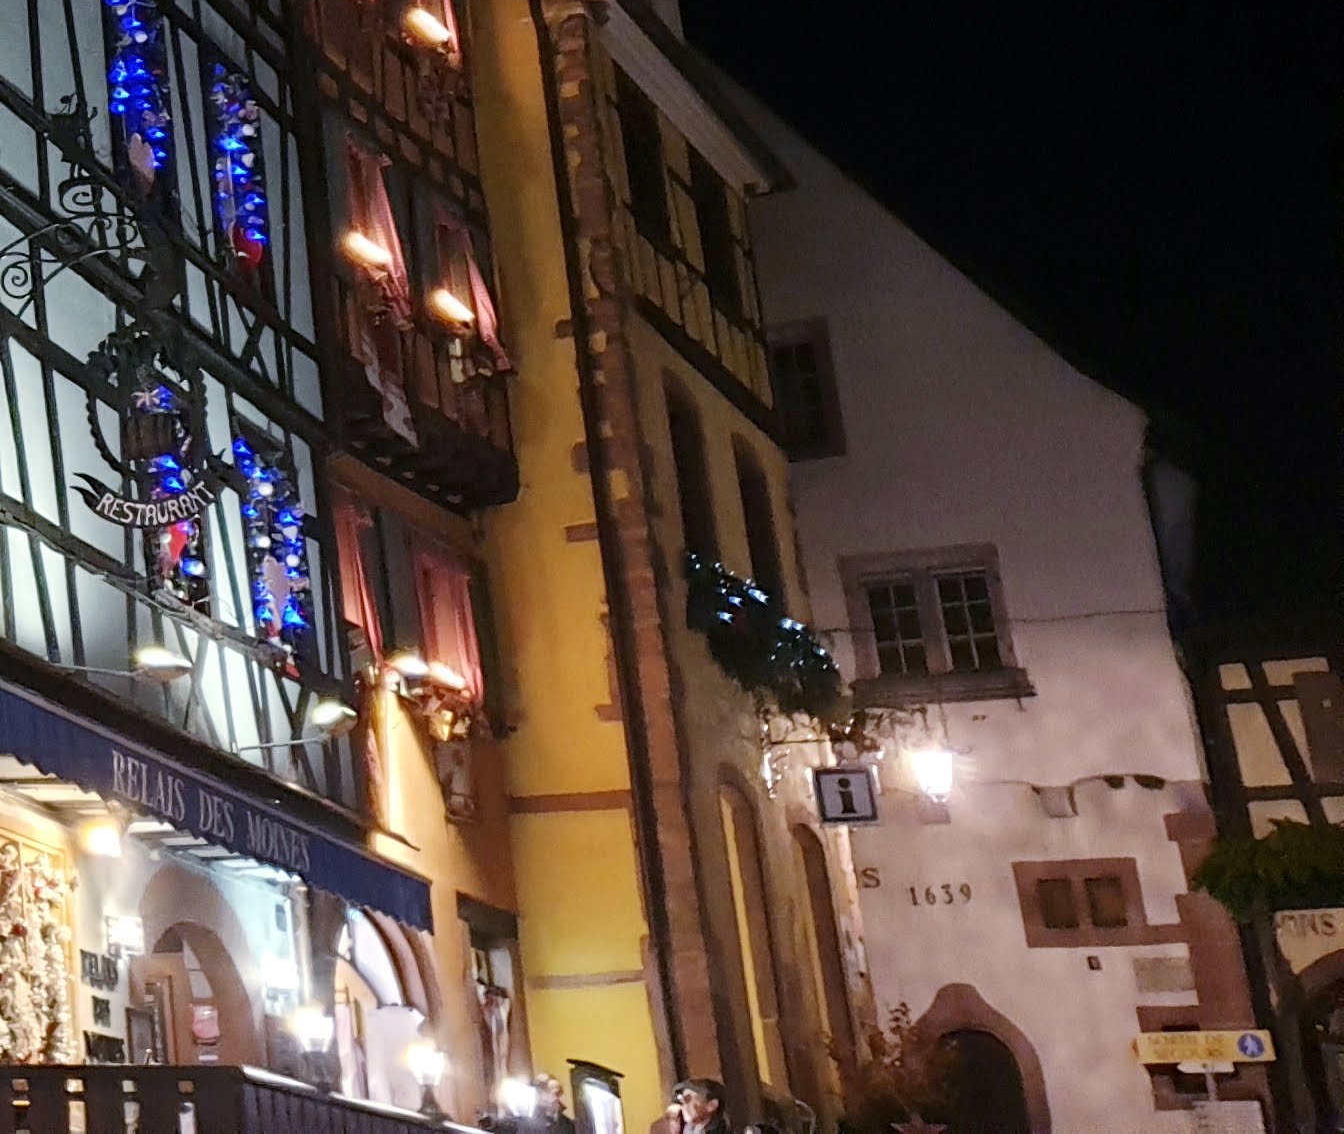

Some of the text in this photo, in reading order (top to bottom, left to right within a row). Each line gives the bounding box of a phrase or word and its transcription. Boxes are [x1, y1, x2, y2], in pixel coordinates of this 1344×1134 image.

[95, 481, 214, 526] RESTAURANT
[112, 749, 186, 822] RELAIS
[198, 788, 234, 844] DES
[909, 882, 972, 907] 1639
